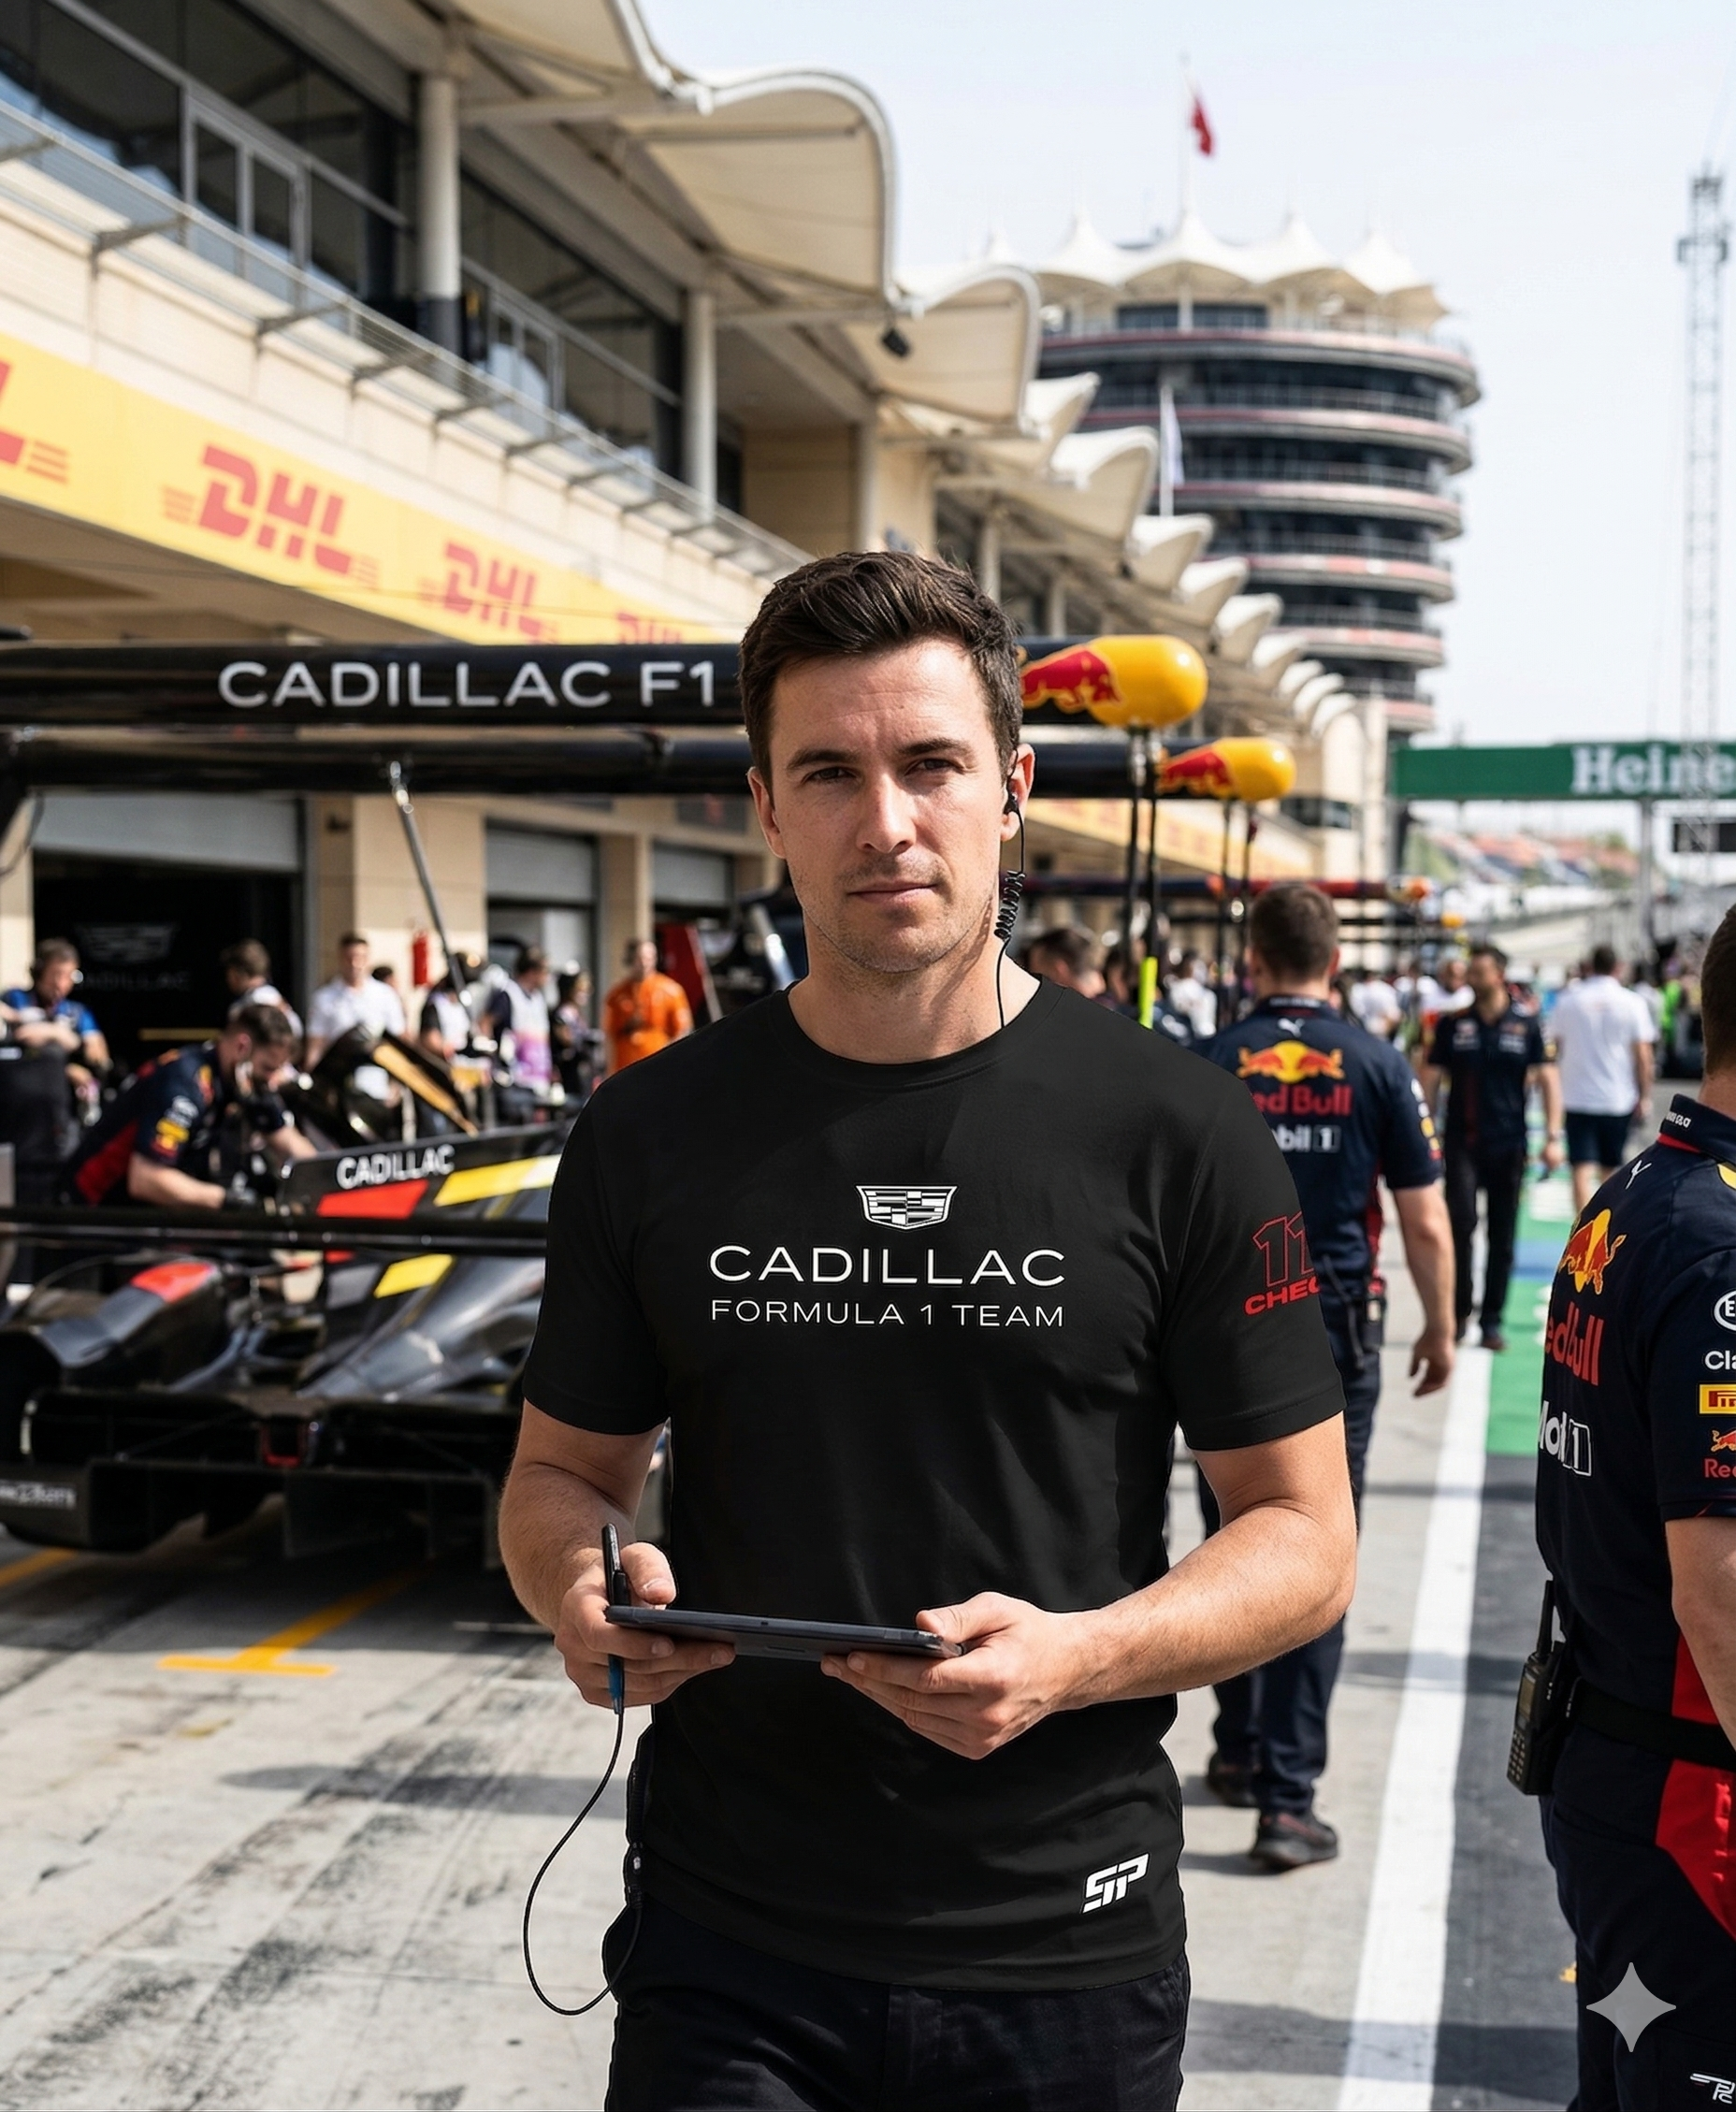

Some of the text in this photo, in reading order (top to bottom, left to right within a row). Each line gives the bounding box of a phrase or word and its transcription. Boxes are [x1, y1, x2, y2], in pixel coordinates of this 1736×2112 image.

[197, 444, 351, 575] DHL
[442, 542, 542, 637] DHL
[218, 660, 716, 708] CADILLAC F1
[337, 1143, 456, 1190] CADILLAC
[709, 1245, 1065, 1287] CADILLAC
[711, 1299, 1063, 1327] FORMULA 1 TEAM
